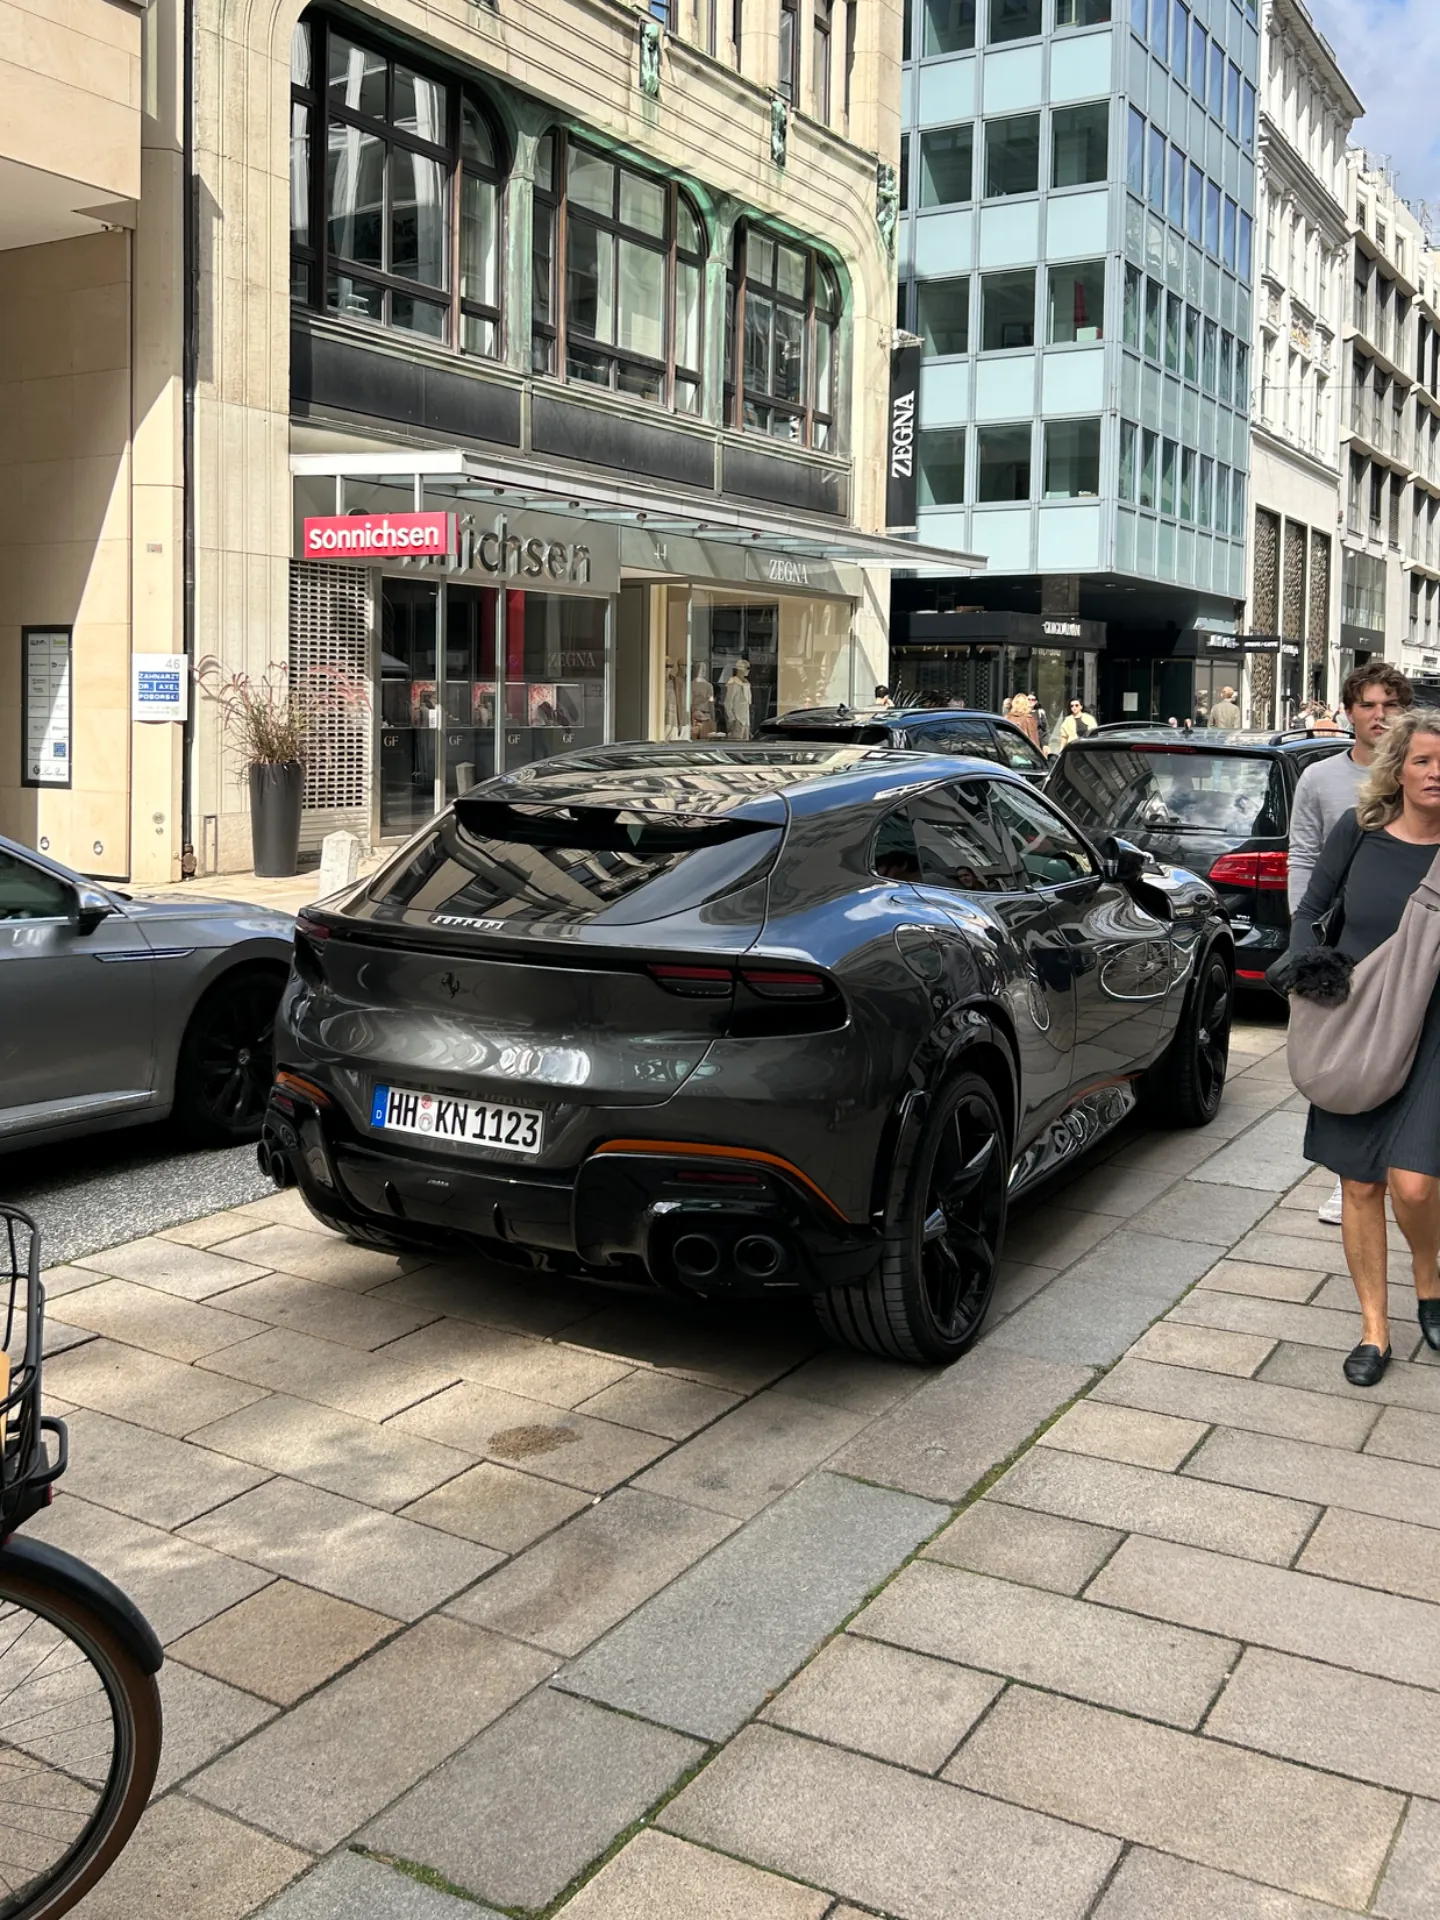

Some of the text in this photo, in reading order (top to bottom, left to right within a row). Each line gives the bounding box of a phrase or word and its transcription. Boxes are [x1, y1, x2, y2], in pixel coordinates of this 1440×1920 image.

[891, 390, 915, 478] ZEGNA
[309, 519, 439, 550] sonnichsen
[769, 559, 809, 584] ZEGNA
[165, 659, 180, 670] 46
[383, 735, 399, 747] GF
[449, 735, 463, 746] GF
[508, 734, 521, 745] GF
[562, 733, 575, 744] GF
[375, 1109, 382, 1119] D
[387, 1092, 540, 1147] HH KN 1123
